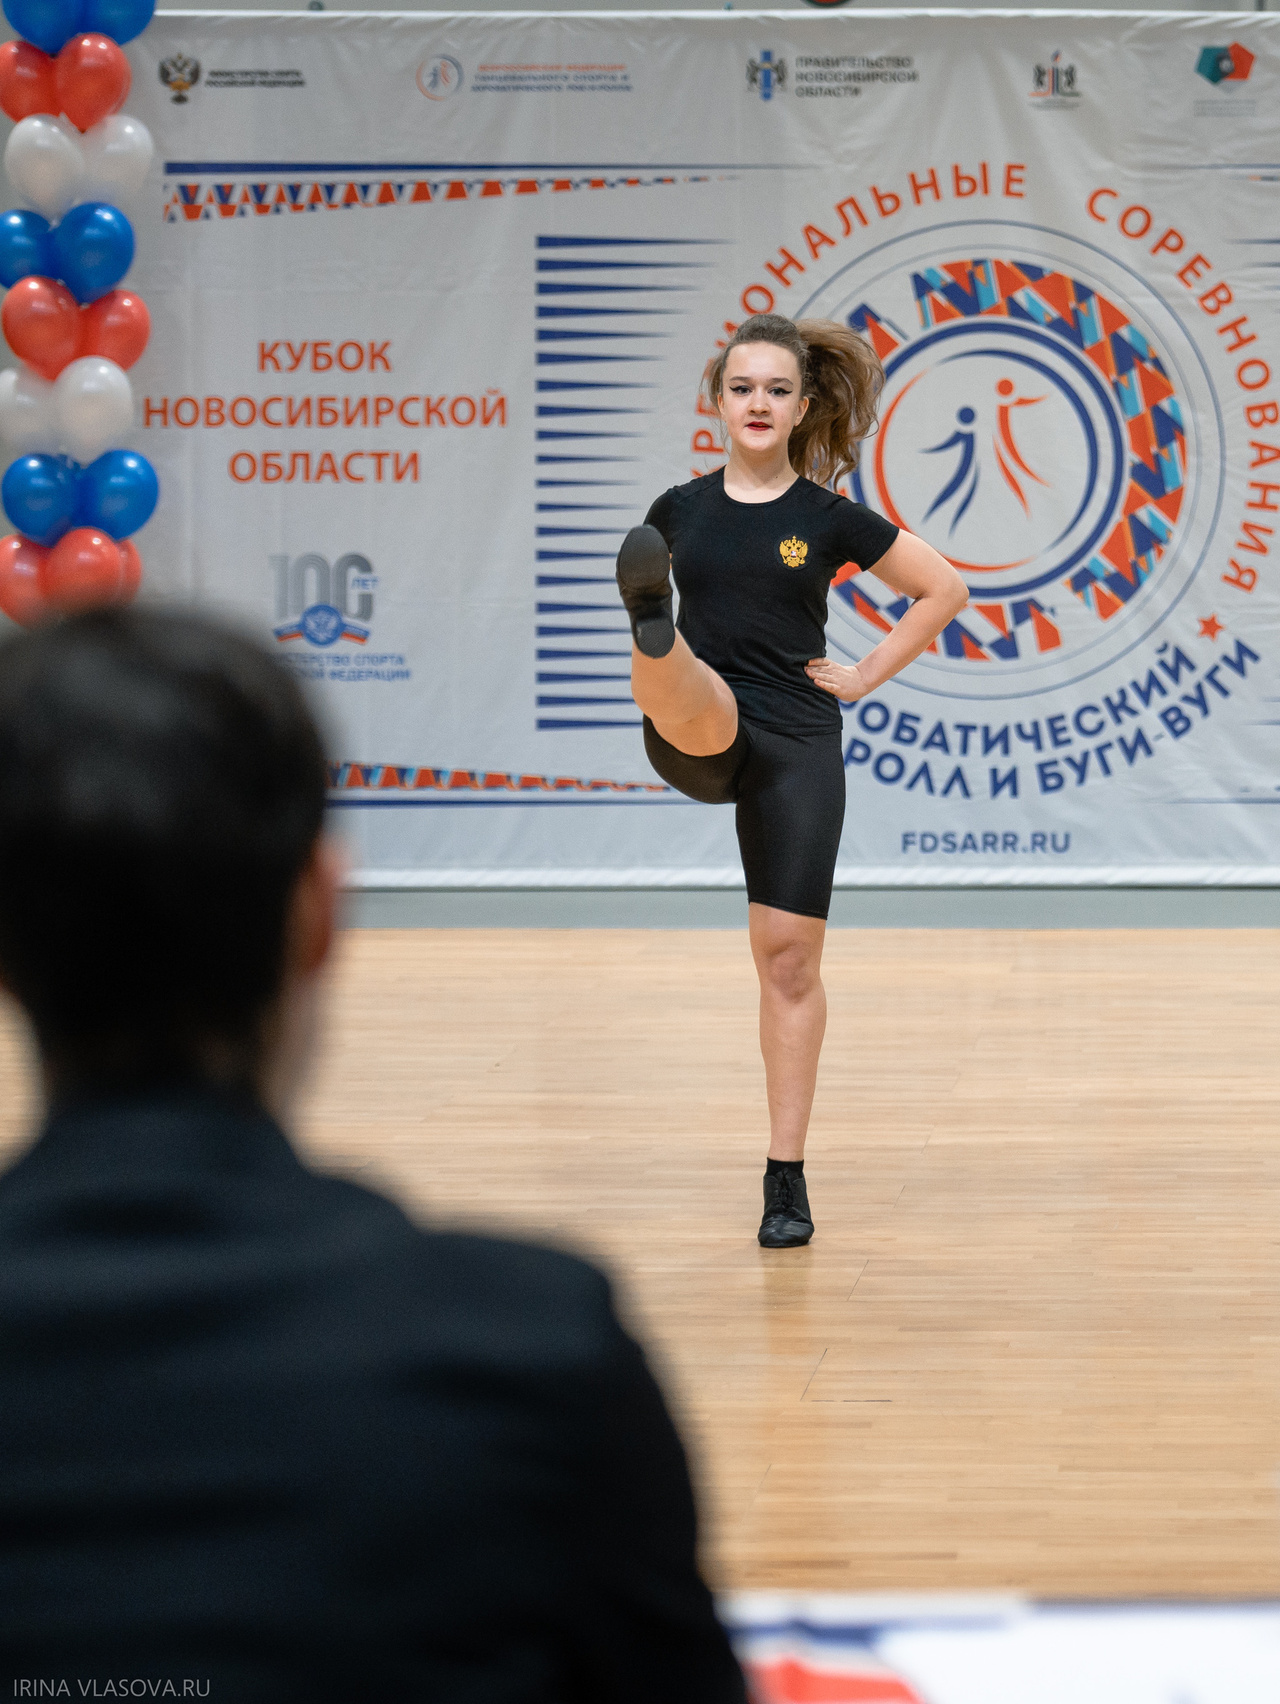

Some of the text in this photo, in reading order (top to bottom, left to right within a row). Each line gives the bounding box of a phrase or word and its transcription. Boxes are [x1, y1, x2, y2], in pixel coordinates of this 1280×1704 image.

[796, 56, 914, 69] ПРАВИТЕЛЬСТВО
[796, 70, 919, 83] НОВОСИБИРСКОЙ
[795, 86, 862, 98] ОБЛАСТИ
[257, 340, 393, 372] КУБОК
[142, 388, 508, 428] НОВОСИБИРСКОЙ
[227, 450, 421, 484] ОБЛАСТИ
[838, 641, 1198, 757] ОБАТИЧЕСКИЙ
[989, 766, 1019, 800] И
[1035, 637, 1262, 796] БУГИ-ВУГИ
[901, 831, 1072, 855] FDSARR.RU
